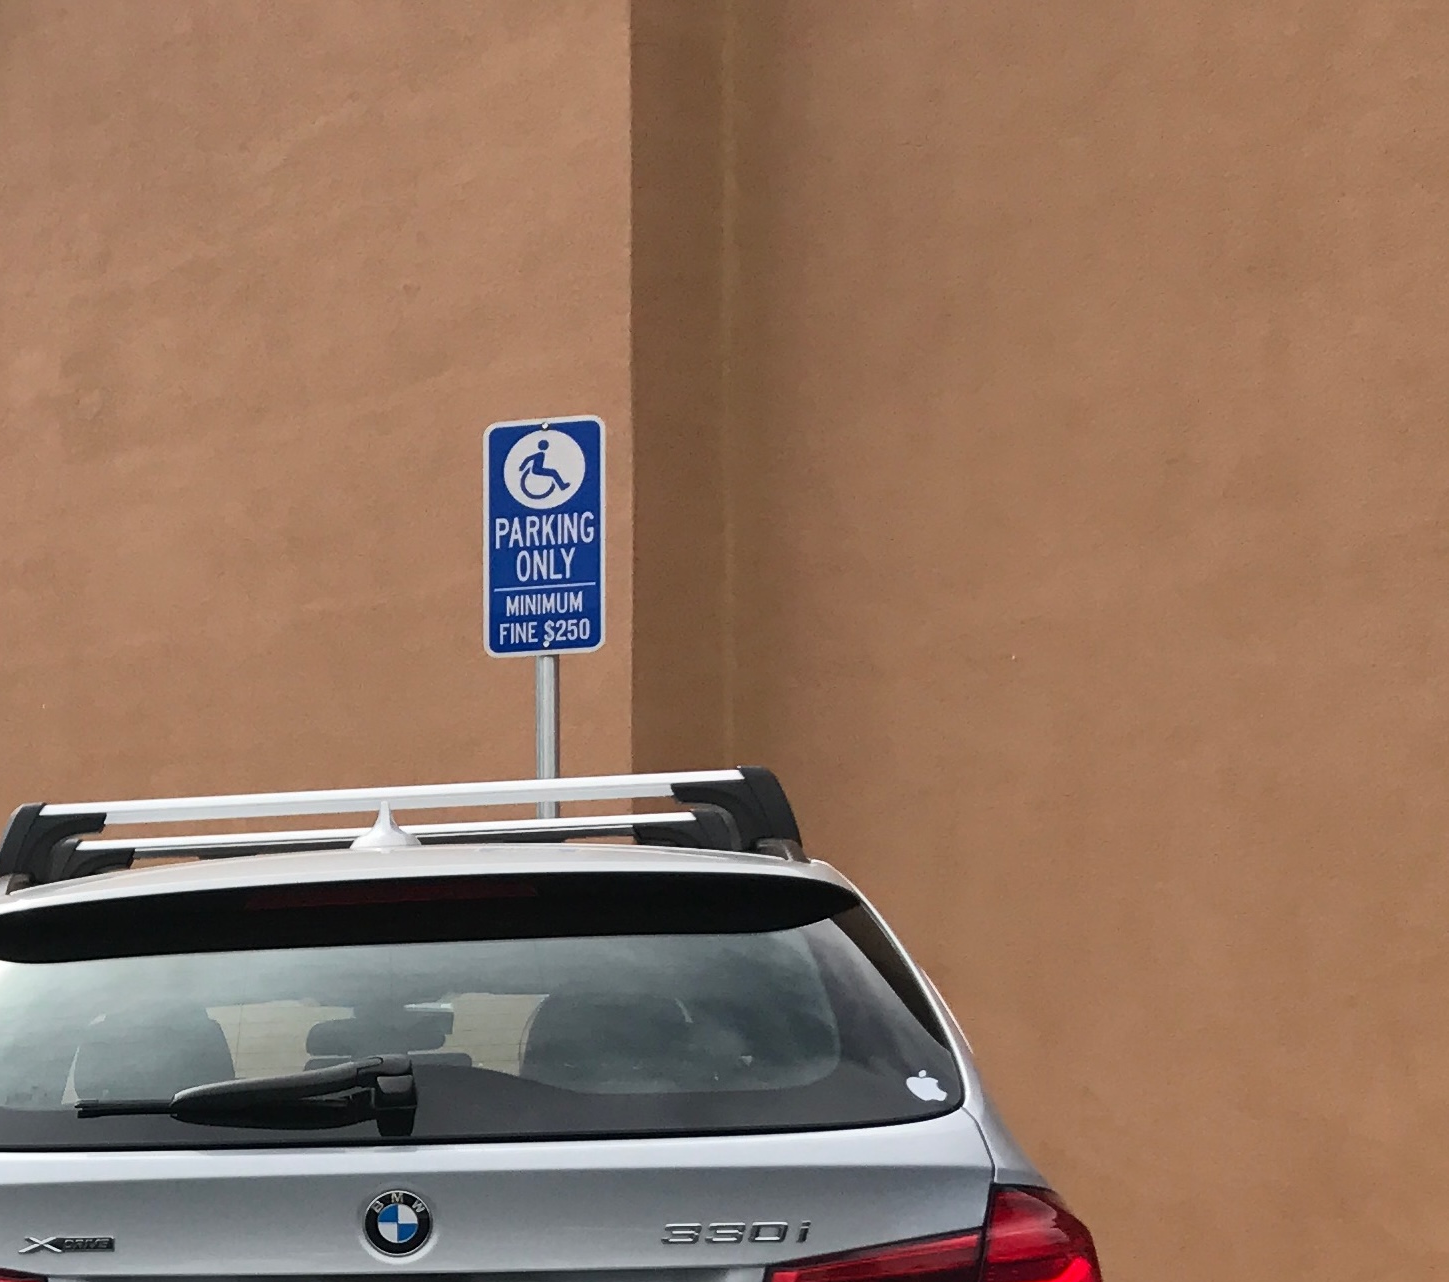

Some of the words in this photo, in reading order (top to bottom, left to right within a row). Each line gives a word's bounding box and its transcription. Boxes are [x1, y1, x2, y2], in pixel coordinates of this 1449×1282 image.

[495, 511, 595, 549] PARKING
[516, 547, 576, 582] ONLY
[505, 590, 583, 617] MINIMUM
[499, 621, 538, 645] FINE
[544, 617, 590, 643] $250
[371, 1191, 425, 1213] BMW
[661, 1220, 811, 1244] 330i
